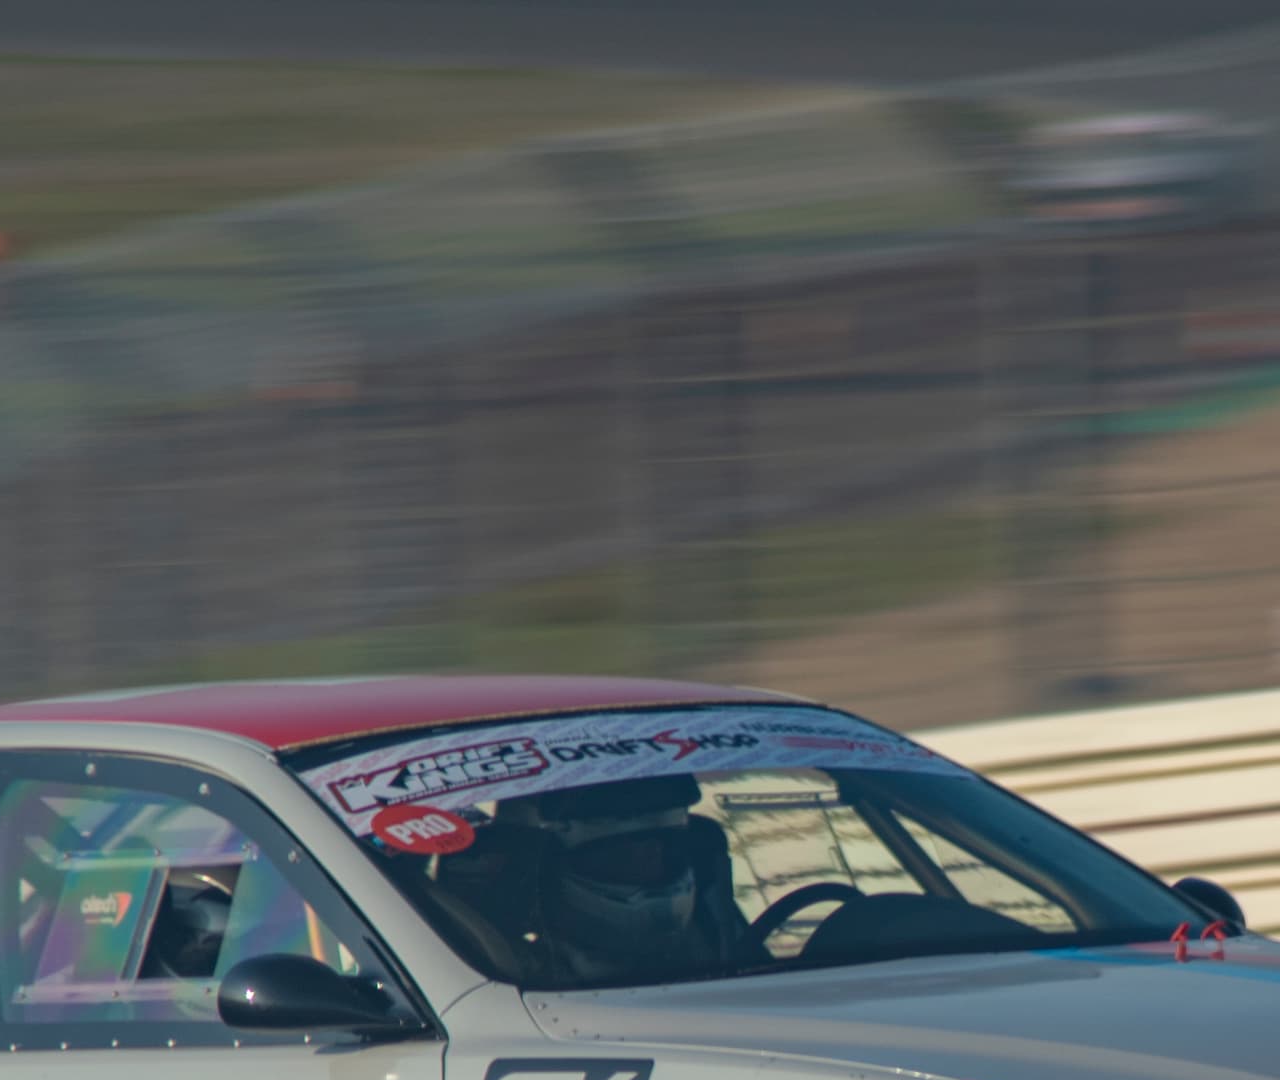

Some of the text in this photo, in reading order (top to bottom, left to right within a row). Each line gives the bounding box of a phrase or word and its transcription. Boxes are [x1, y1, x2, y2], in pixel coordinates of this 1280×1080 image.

[406, 740, 531, 775] DRIFT
[334, 750, 544, 812] KINGS
[385, 813, 447, 845] PRO
